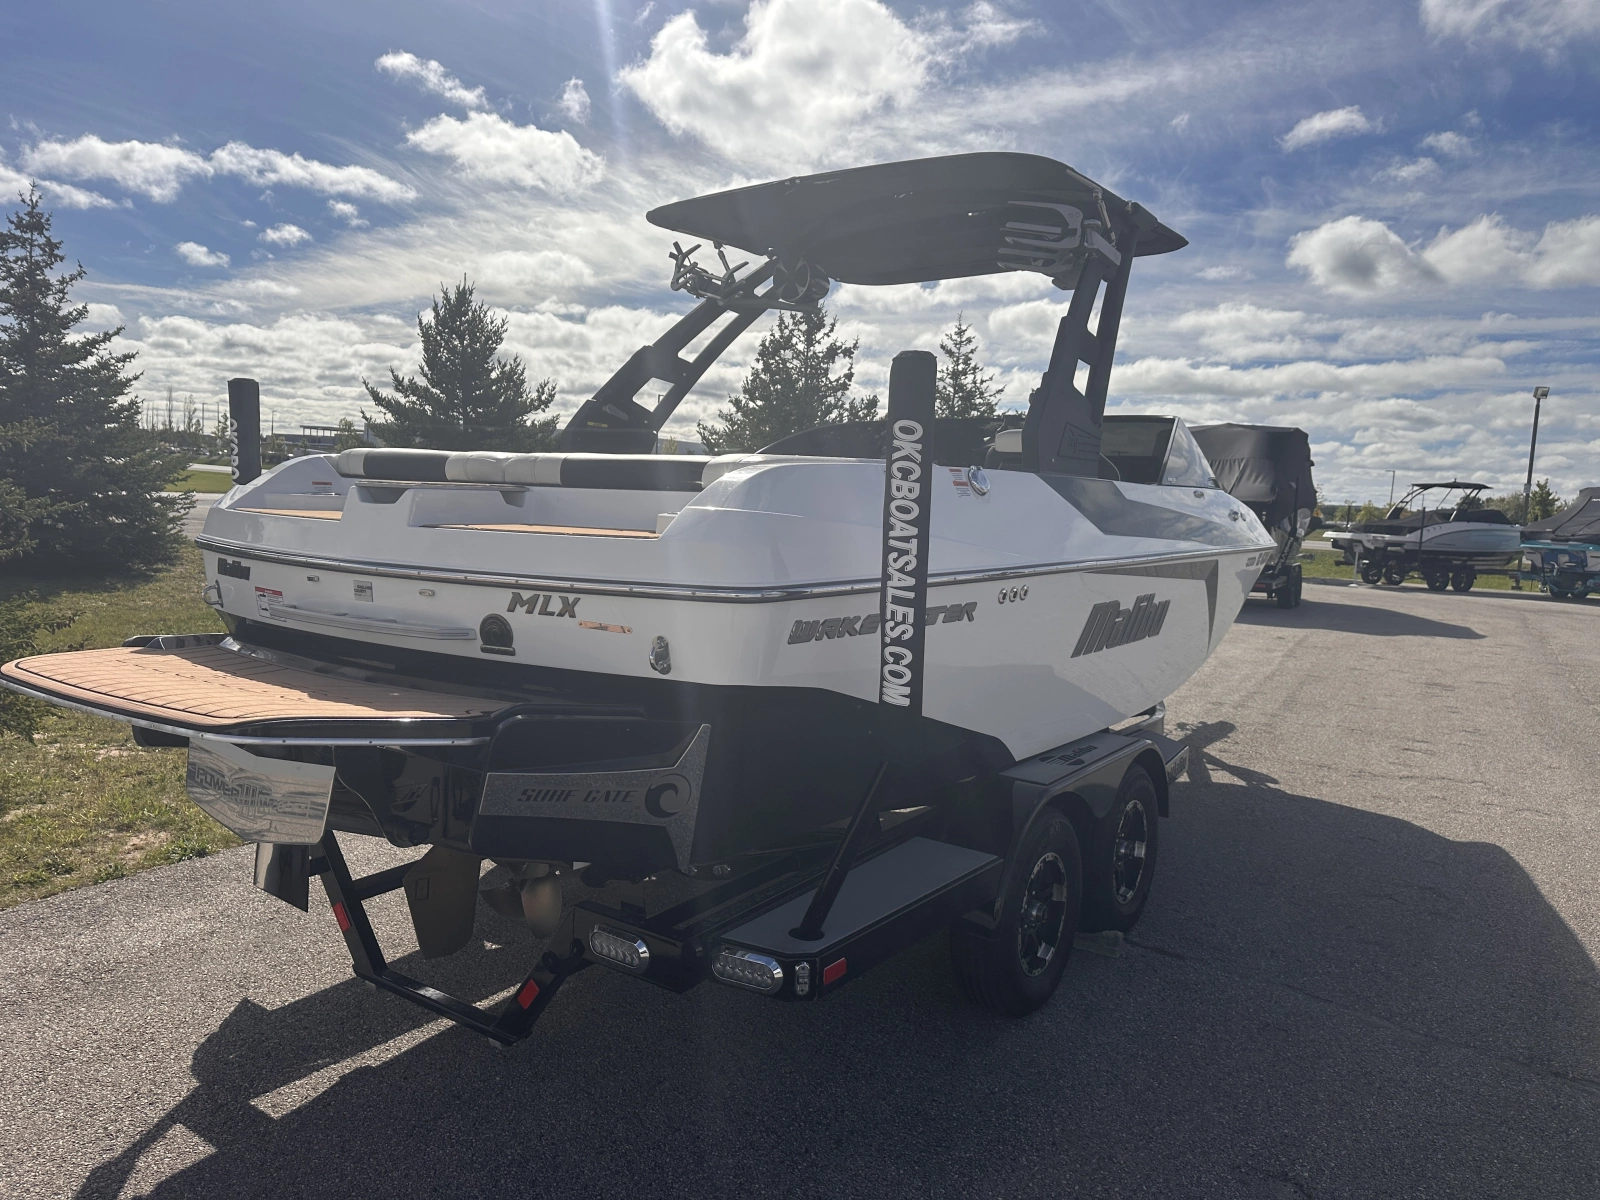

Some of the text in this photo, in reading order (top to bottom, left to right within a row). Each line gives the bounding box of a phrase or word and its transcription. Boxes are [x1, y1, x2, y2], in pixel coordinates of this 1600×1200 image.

[881, 419, 924, 707] OKCBOATSALES.COM
[506, 592, 581, 618] MLX
[1070, 593, 1171, 659] Malibu
[517, 788, 639, 803] SURF GATE
